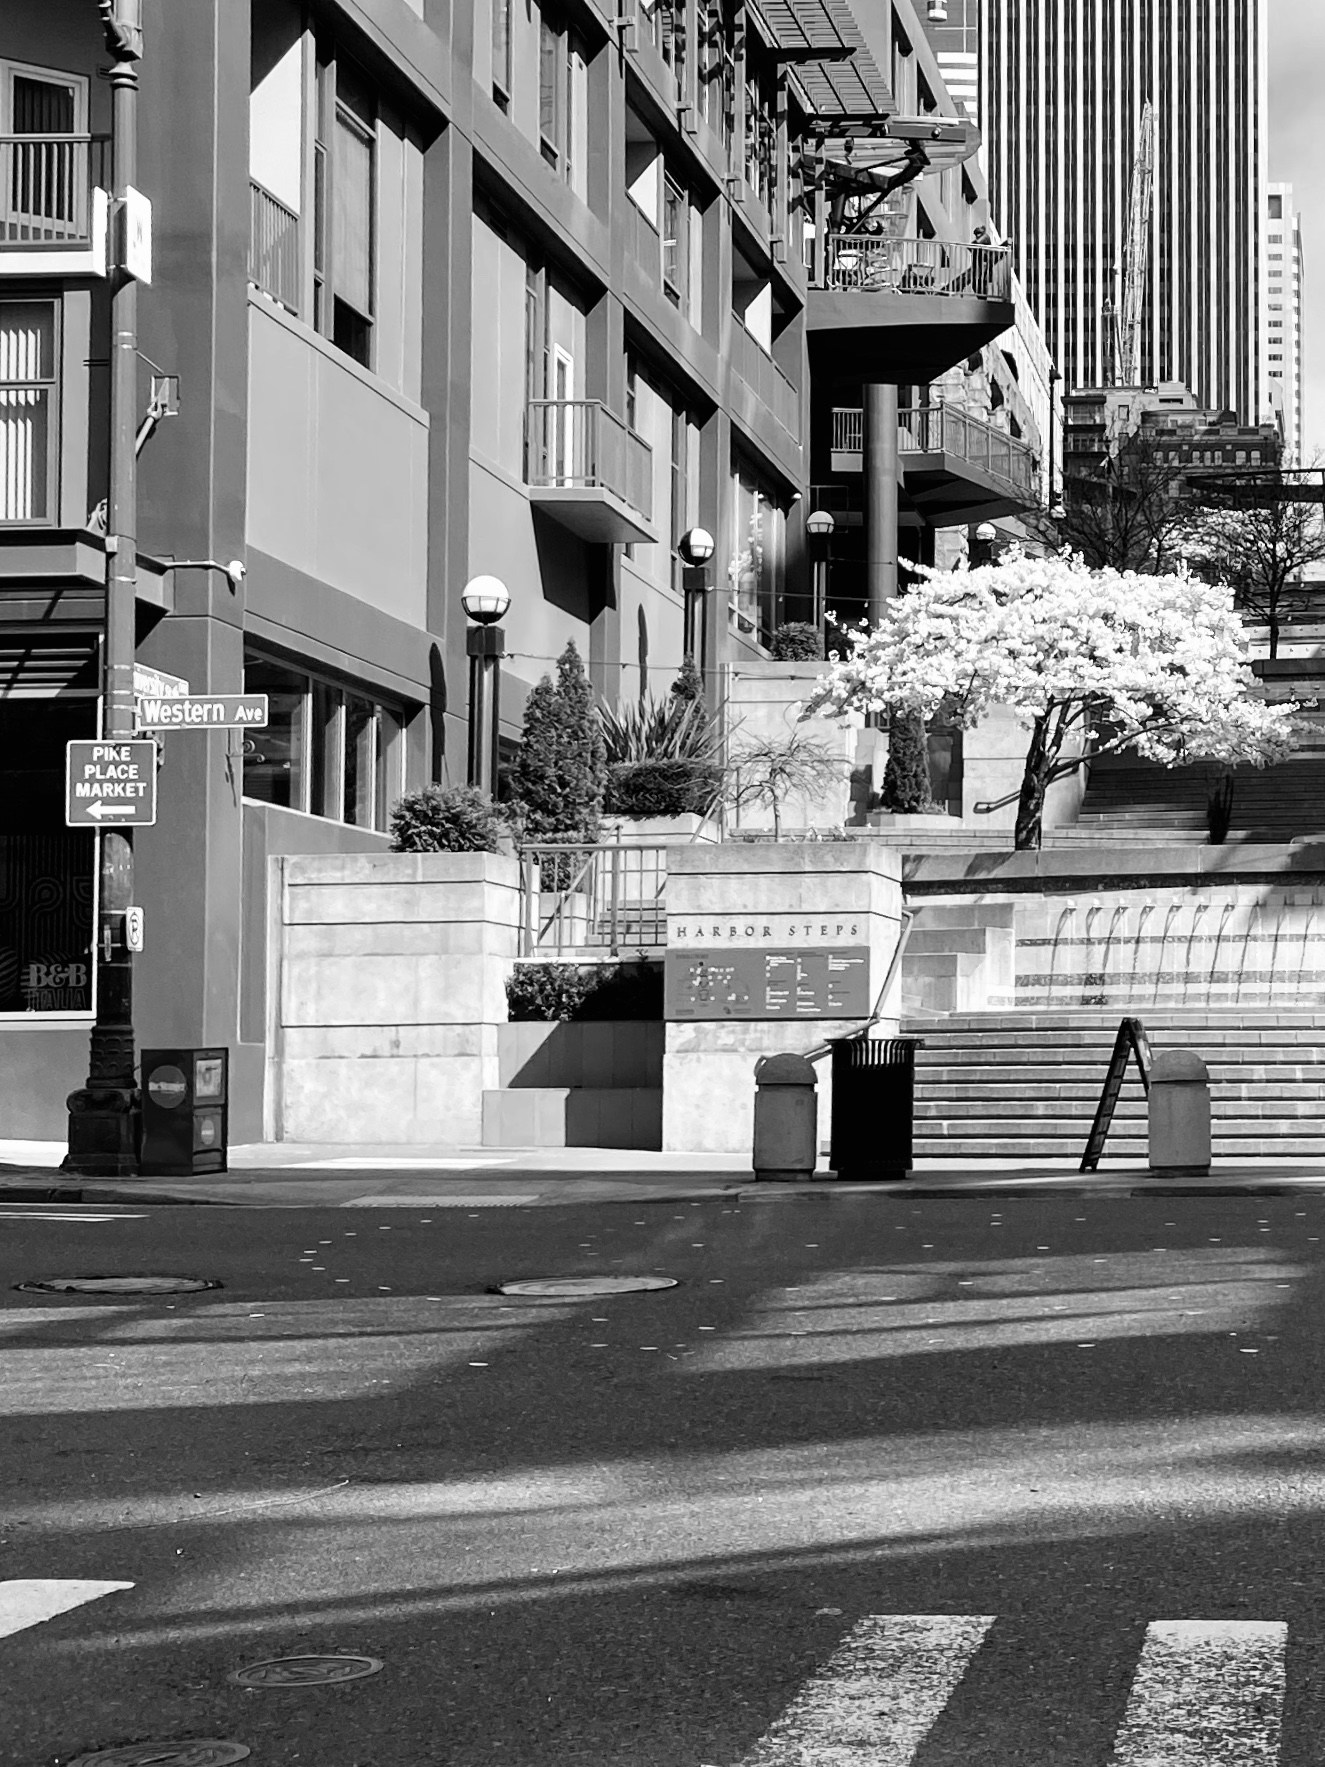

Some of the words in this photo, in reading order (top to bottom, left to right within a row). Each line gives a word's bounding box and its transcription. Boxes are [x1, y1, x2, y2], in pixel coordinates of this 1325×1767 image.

[143, 699, 225, 723] Western
[234, 705, 263, 721] Ave
[92, 746, 132, 762] PIKE
[84, 764, 139, 780] PLACE
[75, 782, 147, 798] MARKET
[677, 925, 772, 938] HARBOR
[788, 924, 858, 937] STEPS
[28, 963, 88, 988] B&B
